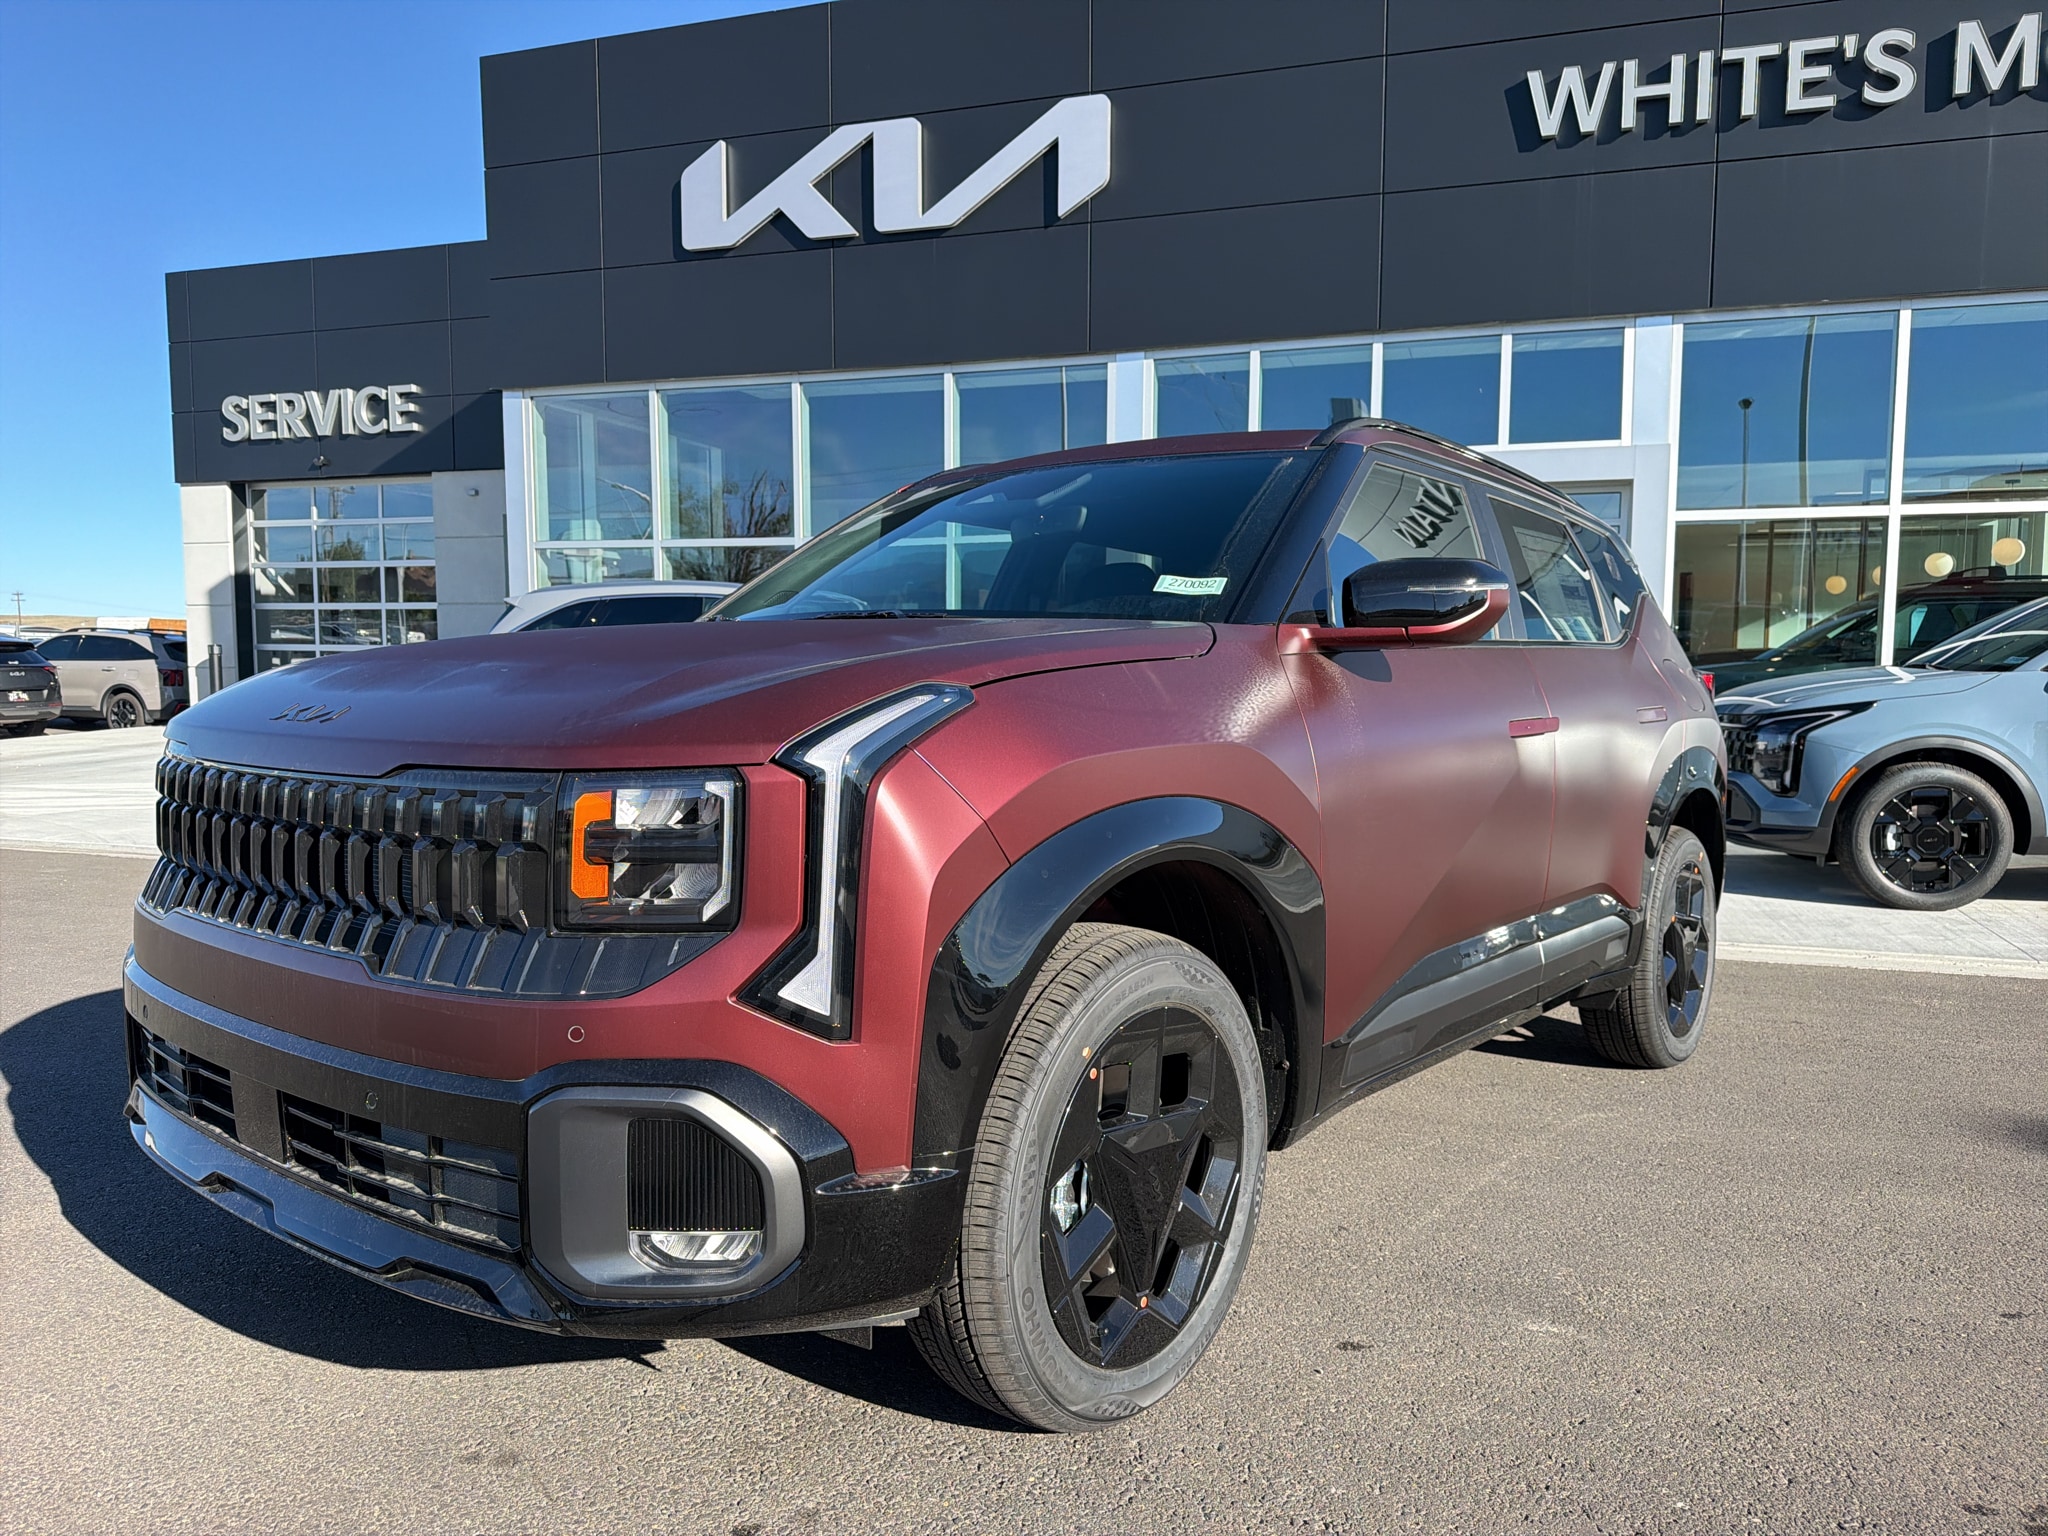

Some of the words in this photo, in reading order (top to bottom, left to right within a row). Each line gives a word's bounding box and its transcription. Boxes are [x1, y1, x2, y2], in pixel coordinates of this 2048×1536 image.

[1526, 28, 1918, 139] WHITE'S
[1952, 11, 2048, 98] M
[681, 94, 1111, 251] KIA
[221, 383, 421, 442] SERVICE
[1168, 577, 1218, 589] 270092
[1021, 1286, 1069, 1388] KUMHO
